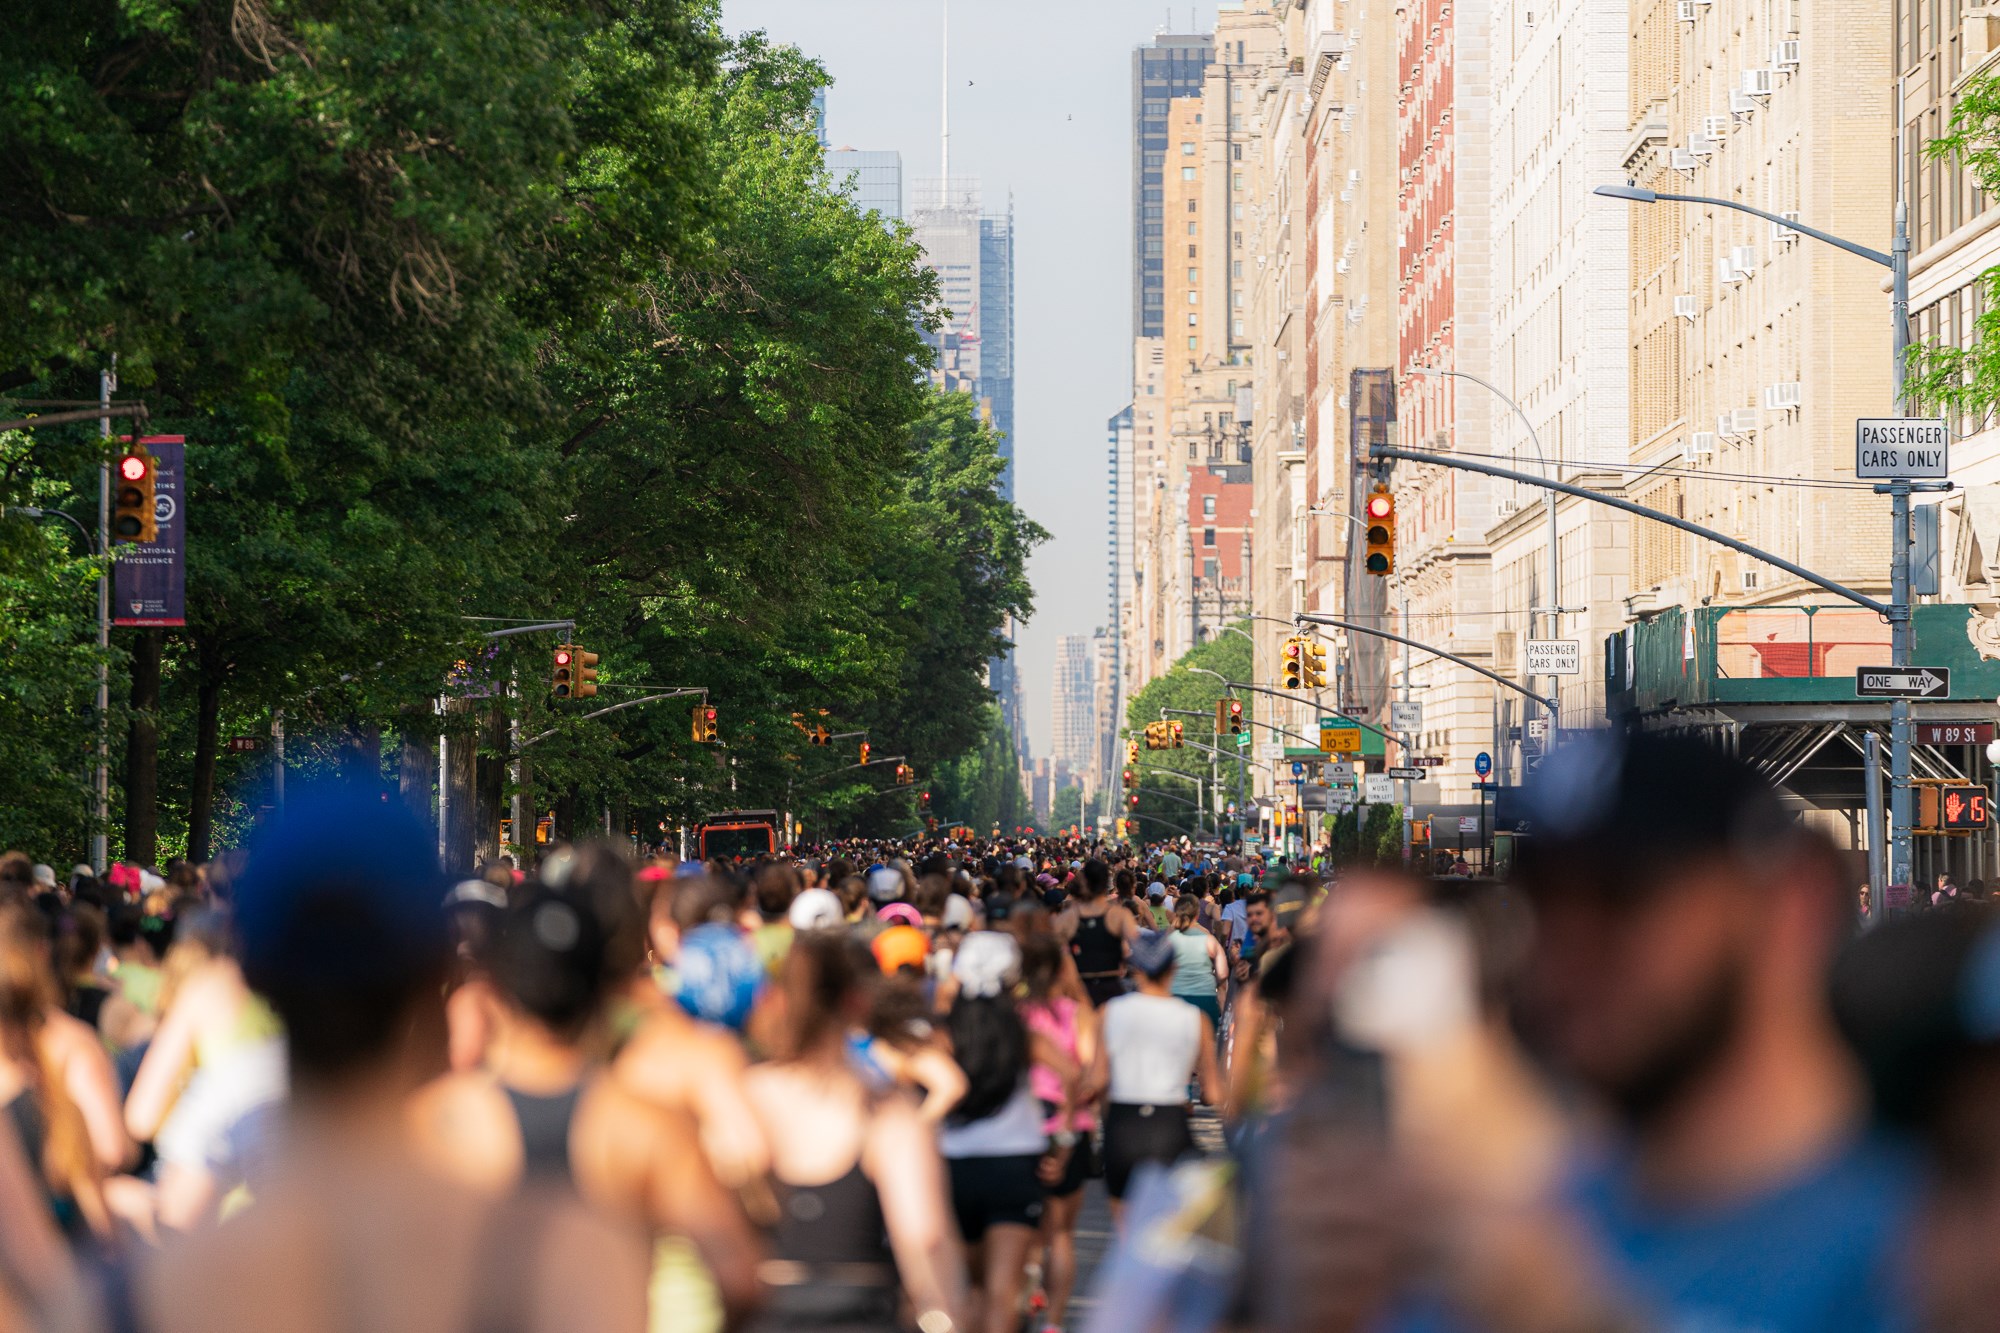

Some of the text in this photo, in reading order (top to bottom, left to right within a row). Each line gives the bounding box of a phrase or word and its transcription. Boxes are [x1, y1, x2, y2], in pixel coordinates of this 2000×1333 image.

[1863, 427, 1942, 444] PASSENGER
[1862, 450, 1942, 467] CARS ONLY
[1529, 645, 1576, 655] PASSENGER
[1529, 659, 1576, 668] CARS ONLY
[1866, 675, 1934, 688] ONE WAY
[1932, 727, 1976, 742] W 89 St
[236, 739, 254, 750] W 88
[1970, 796, 1985, 822] 15
